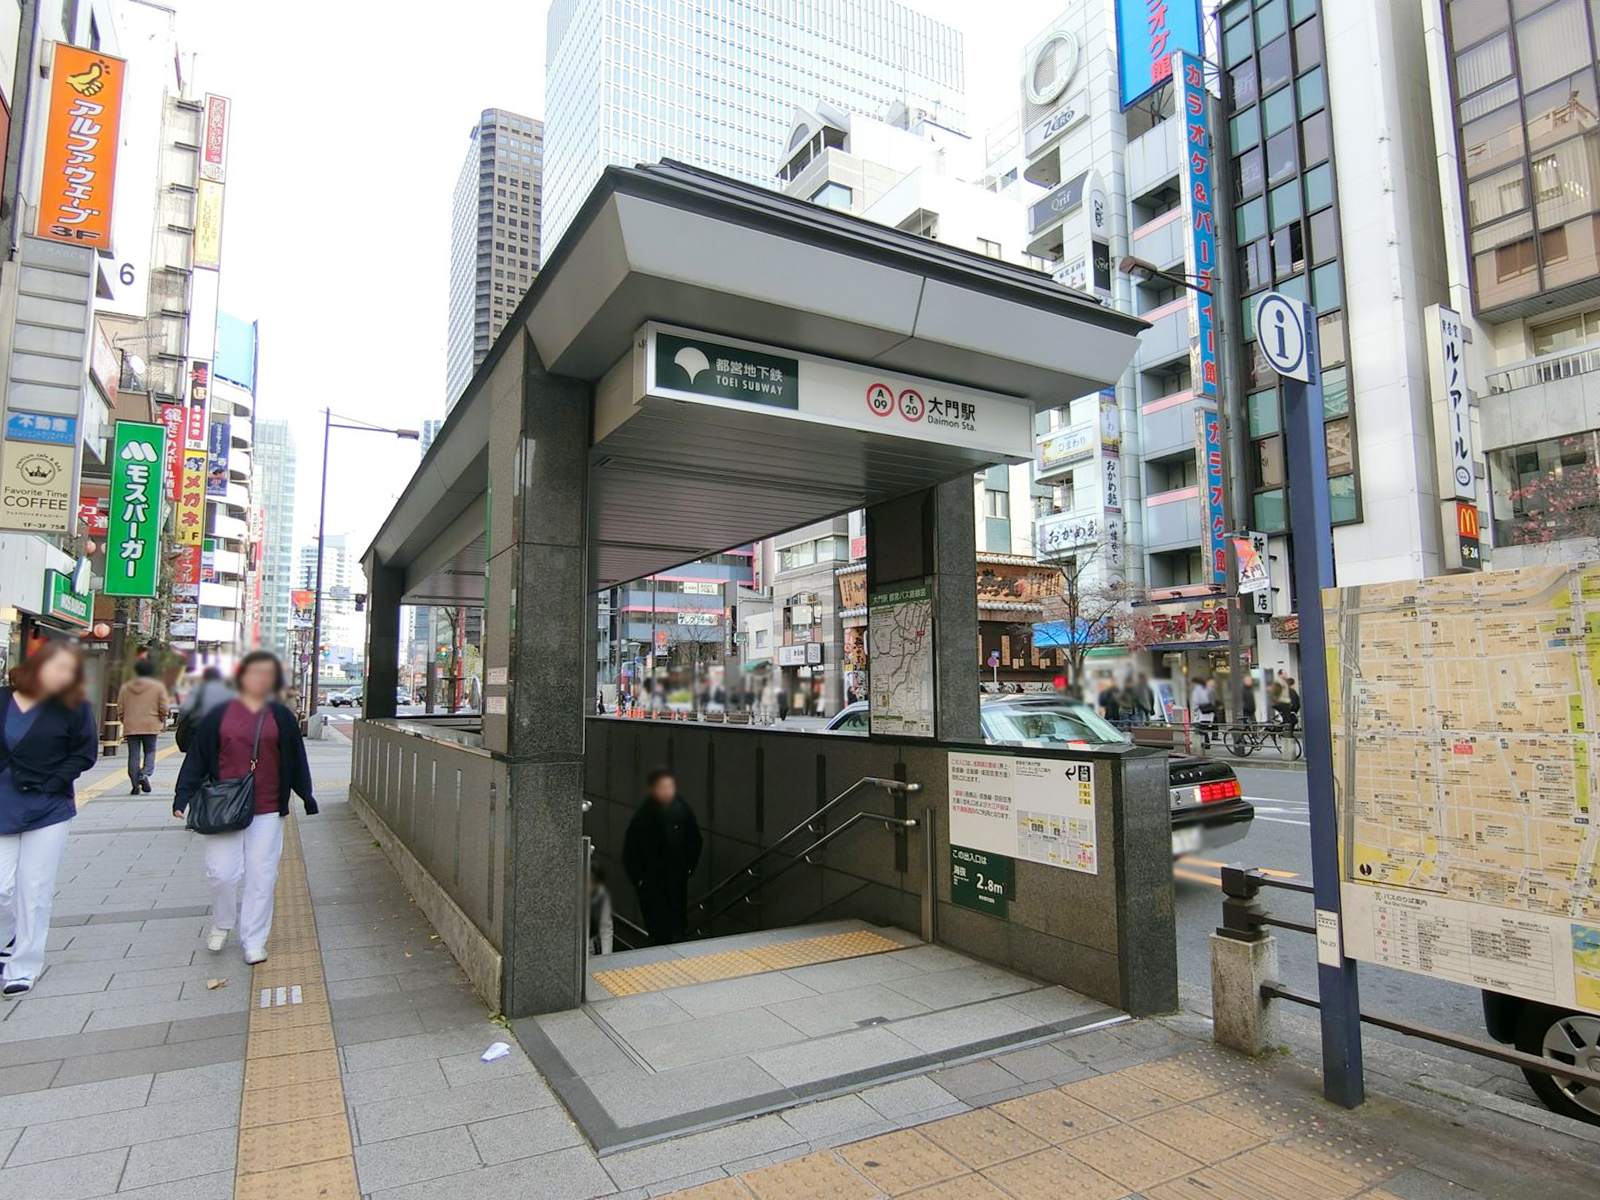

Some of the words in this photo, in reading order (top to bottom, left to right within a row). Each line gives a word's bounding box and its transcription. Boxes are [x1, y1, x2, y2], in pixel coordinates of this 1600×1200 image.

[50, 225, 101, 240] 3F
[119, 263, 136, 286] 6
[715, 358, 783, 383] 都営地下鉄
[715, 374, 739, 388] TOEI
[742, 380, 783, 396] SUBWAY
[876, 389, 885, 399] A
[873, 398, 888, 410] 09
[909, 395, 915, 405] E
[927, 397, 976, 422] 大門駅
[1445, 340, 1468, 460] ルノアール
[905, 405, 919, 416] 20
[927, 414, 960, 430] Daimon
[961, 421, 977, 432] Sta.
[4, 486, 43, 497] Favorite
[45, 489, 69, 499] Time
[181, 474, 201, 527] メガネ
[3, 495, 68, 511] COFFEE
[122, 464, 149, 578] モスバーガー
[976, 872, 1003, 895] 2.8m
